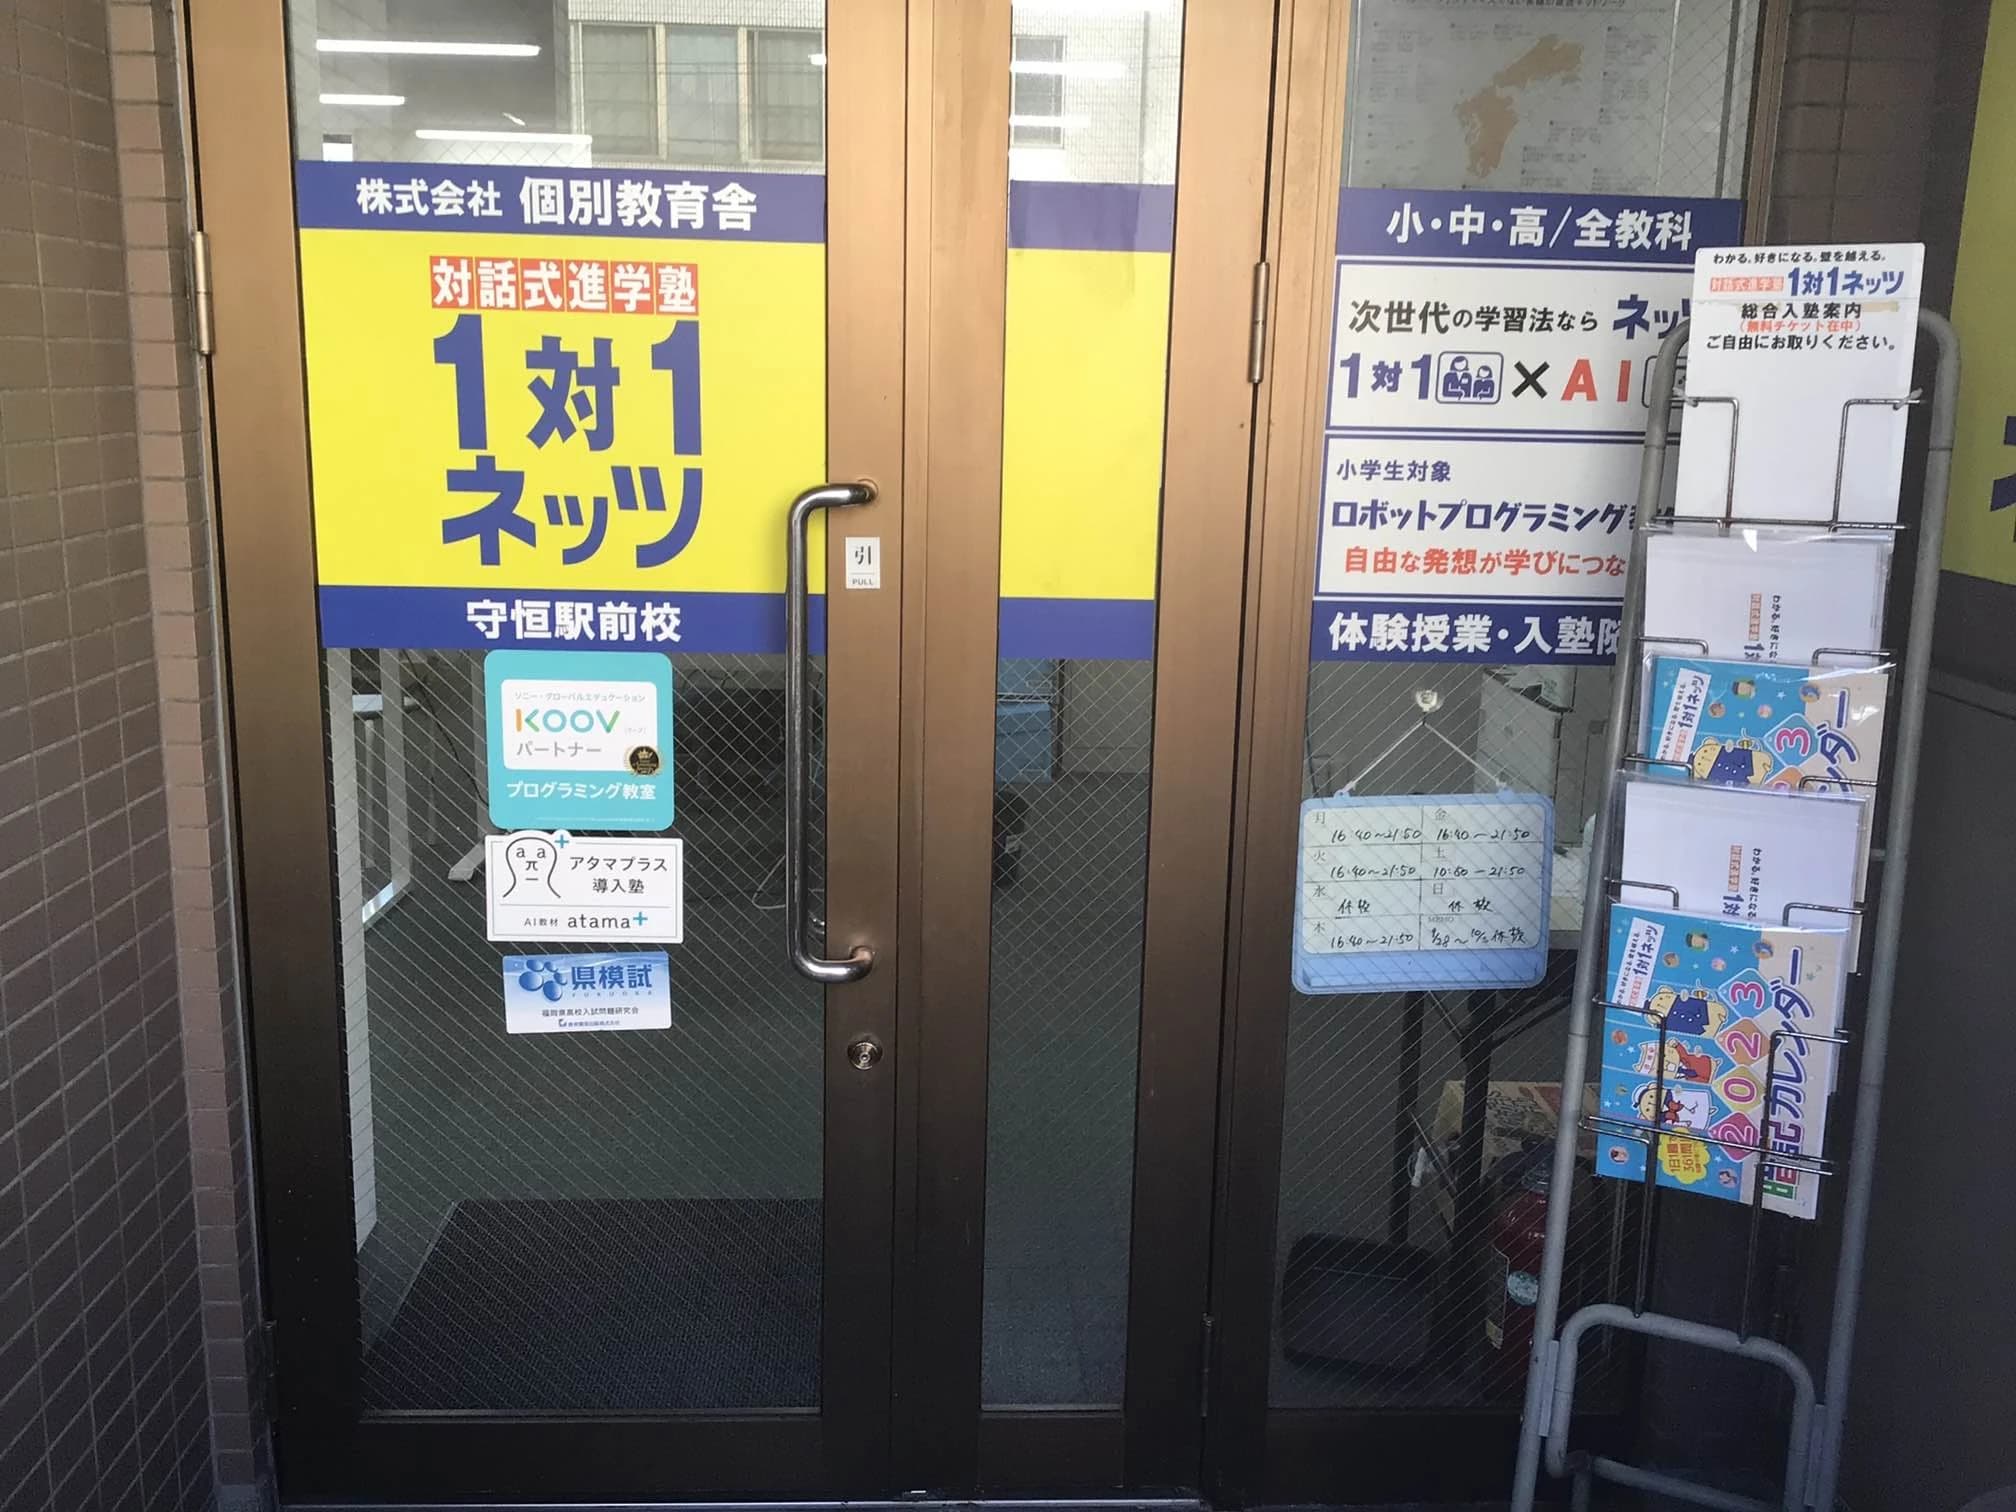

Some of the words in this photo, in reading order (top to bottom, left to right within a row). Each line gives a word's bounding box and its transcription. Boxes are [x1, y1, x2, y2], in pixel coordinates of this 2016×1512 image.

[356, 178, 503, 217] 株式会社
[519, 177, 758, 232] 個別教育舎
[432, 257, 697, 316] 対話式進学塾
[1787, 266, 1905, 297] 1対1ネッツ
[1348, 299, 1600, 335] 次世代の学習法なら
[1612, 293, 1691, 340] ネッ
[1741, 302, 1862, 320] 総合入塾案内
[1707, 334, 1896, 351] ご自由にお取りください。
[433, 313, 703, 457] 1対1
[1340, 352, 1431, 401] 1対1
[1561, 358, 1632, 403] AI
[1336, 458, 1452, 484] 小学生対象
[442, 455, 704, 569] ネッツ
[1331, 497, 1638, 534] ロボットプログラミング
[854, 544, 872, 566] 引
[1345, 545, 1626, 578] 自由な発想が学びにつな
[852, 578, 872, 586] PULL
[466, 599, 682, 643] 守恒駅前校
[515, 708, 621, 734] KOOV
[516, 741, 602, 758] パートナー
[506, 780, 657, 802] プログラミング教室
[1314, 811, 1326, 824] 月
[1434, 807, 1449, 821] 金
[1313, 850, 1326, 862] 火
[1433, 846, 1446, 859] 土
[568, 856, 669, 873] アタマプラス
[592, 878, 645, 894] 導入塾
[1313, 885, 1327, 898] 水
[1432, 883, 1444, 895] 日
[524, 916, 559, 928] AI教材
[1314, 922, 1326, 934] 木
[1633, 925, 1658, 976] 1対1ネッツ
[571, 964, 653, 990] 県模試
[1723, 981, 1765, 1149] 2023
